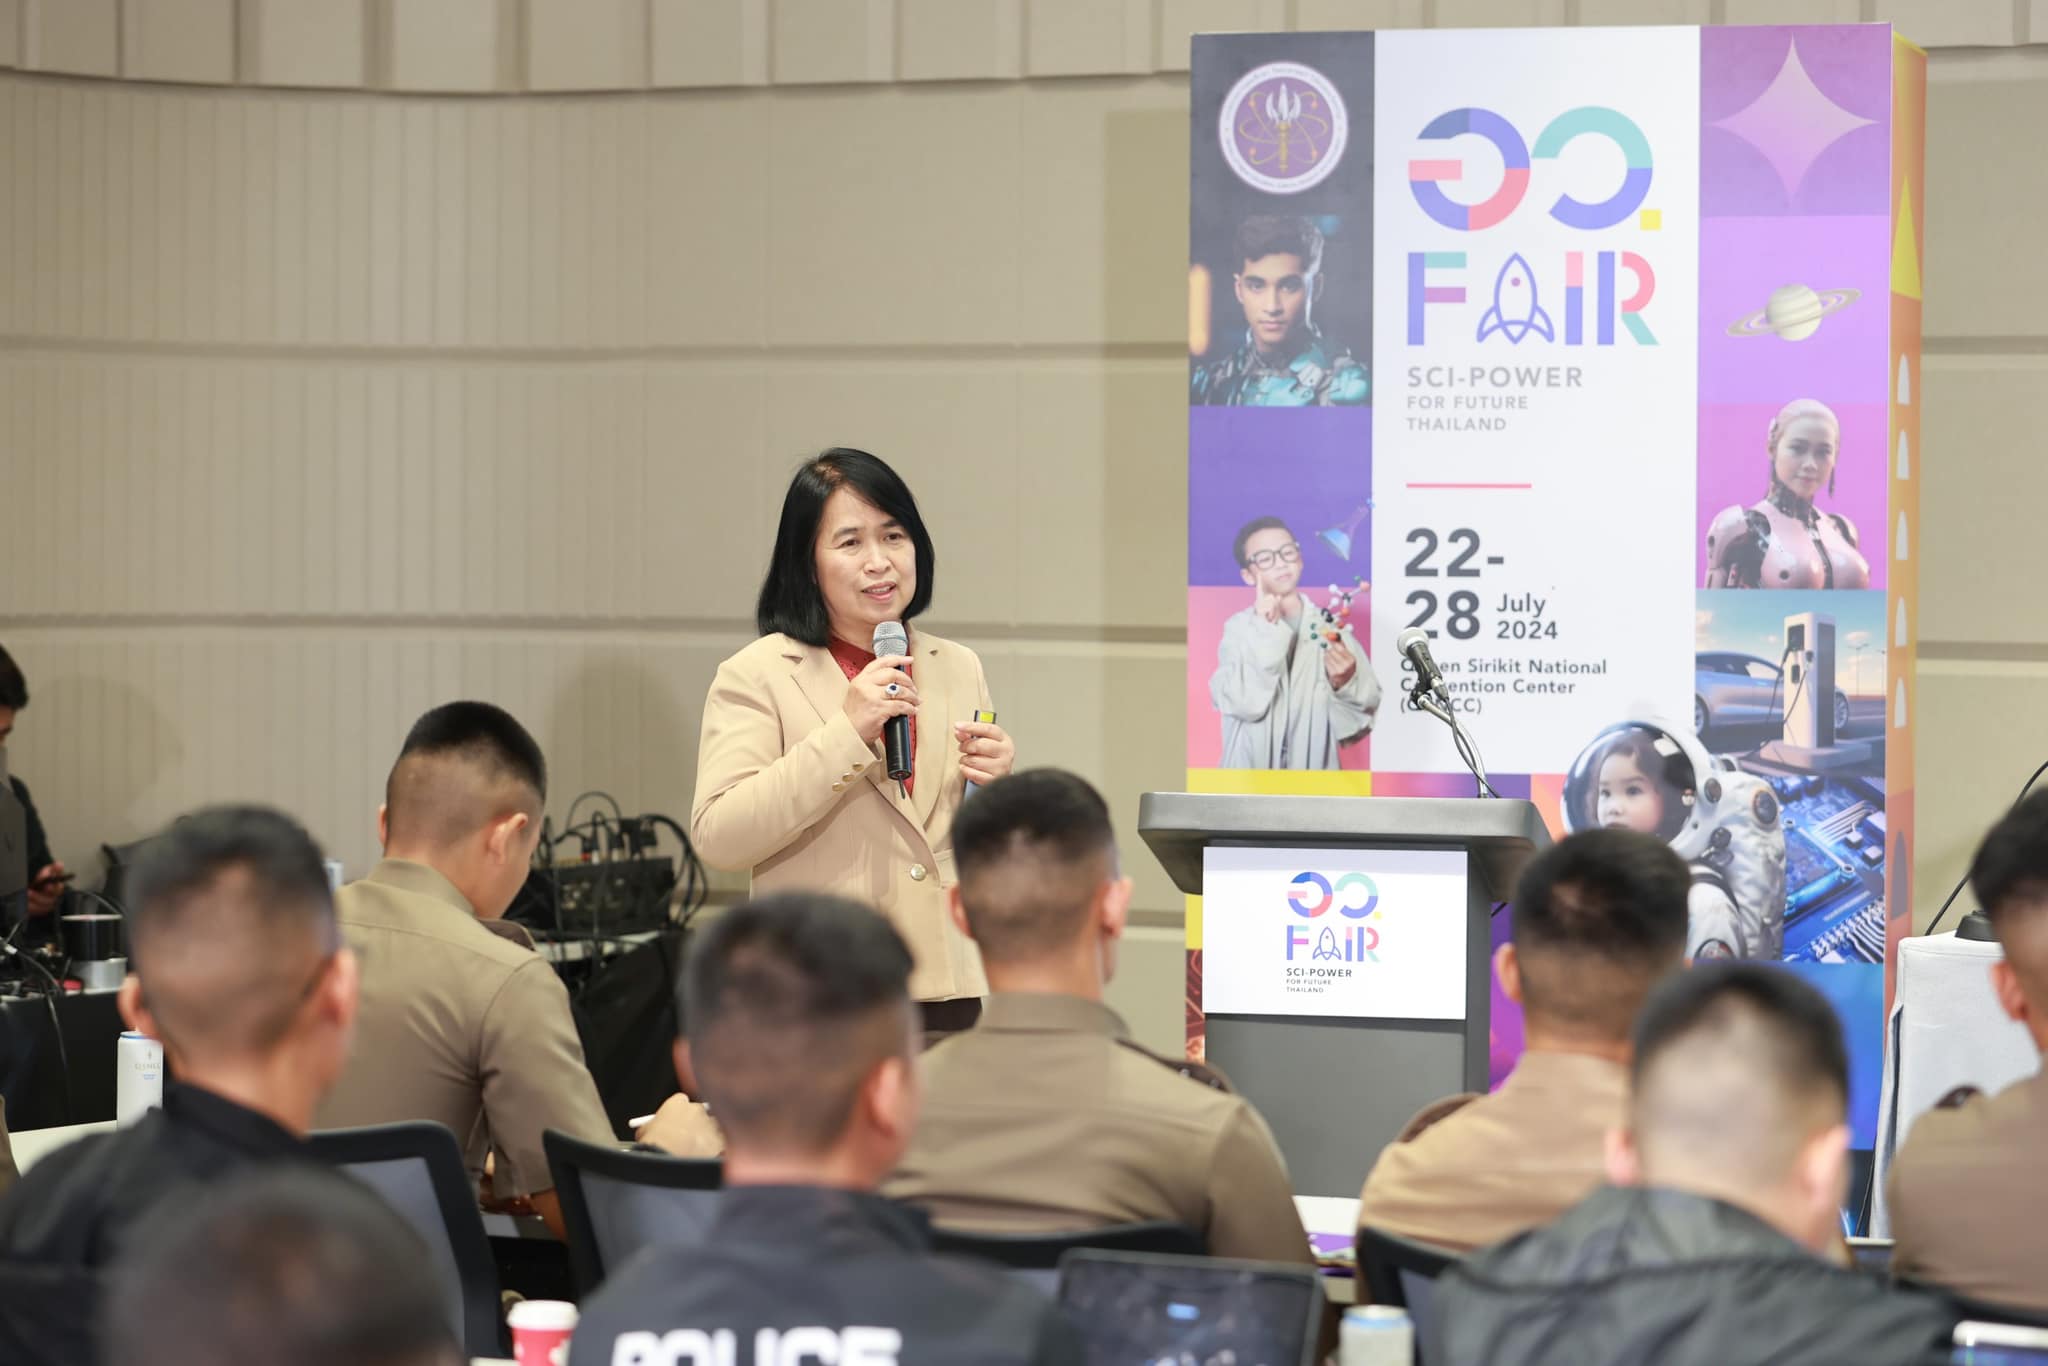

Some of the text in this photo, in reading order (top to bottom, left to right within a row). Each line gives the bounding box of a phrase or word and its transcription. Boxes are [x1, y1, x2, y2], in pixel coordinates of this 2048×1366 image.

[1407, 251, 1660, 346] FAIR
[1407, 366, 1583, 388] SCI-POWER
[1407, 395, 1528, 410] FOR FUTURE
[1407, 417, 1507, 431] THAILAND
[1404, 528, 1504, 577] 22-
[1404, 590, 1480, 640] 28
[1496, 592, 1546, 618] July
[1496, 620, 1558, 639] 2024
[1401, 657, 1607, 675] Qen Sirikit National
[1401, 677, 1576, 694] Cention Center
[1286, 925, 1380, 962] FAIR
[1286, 967, 1352, 977] SCI-POWER
